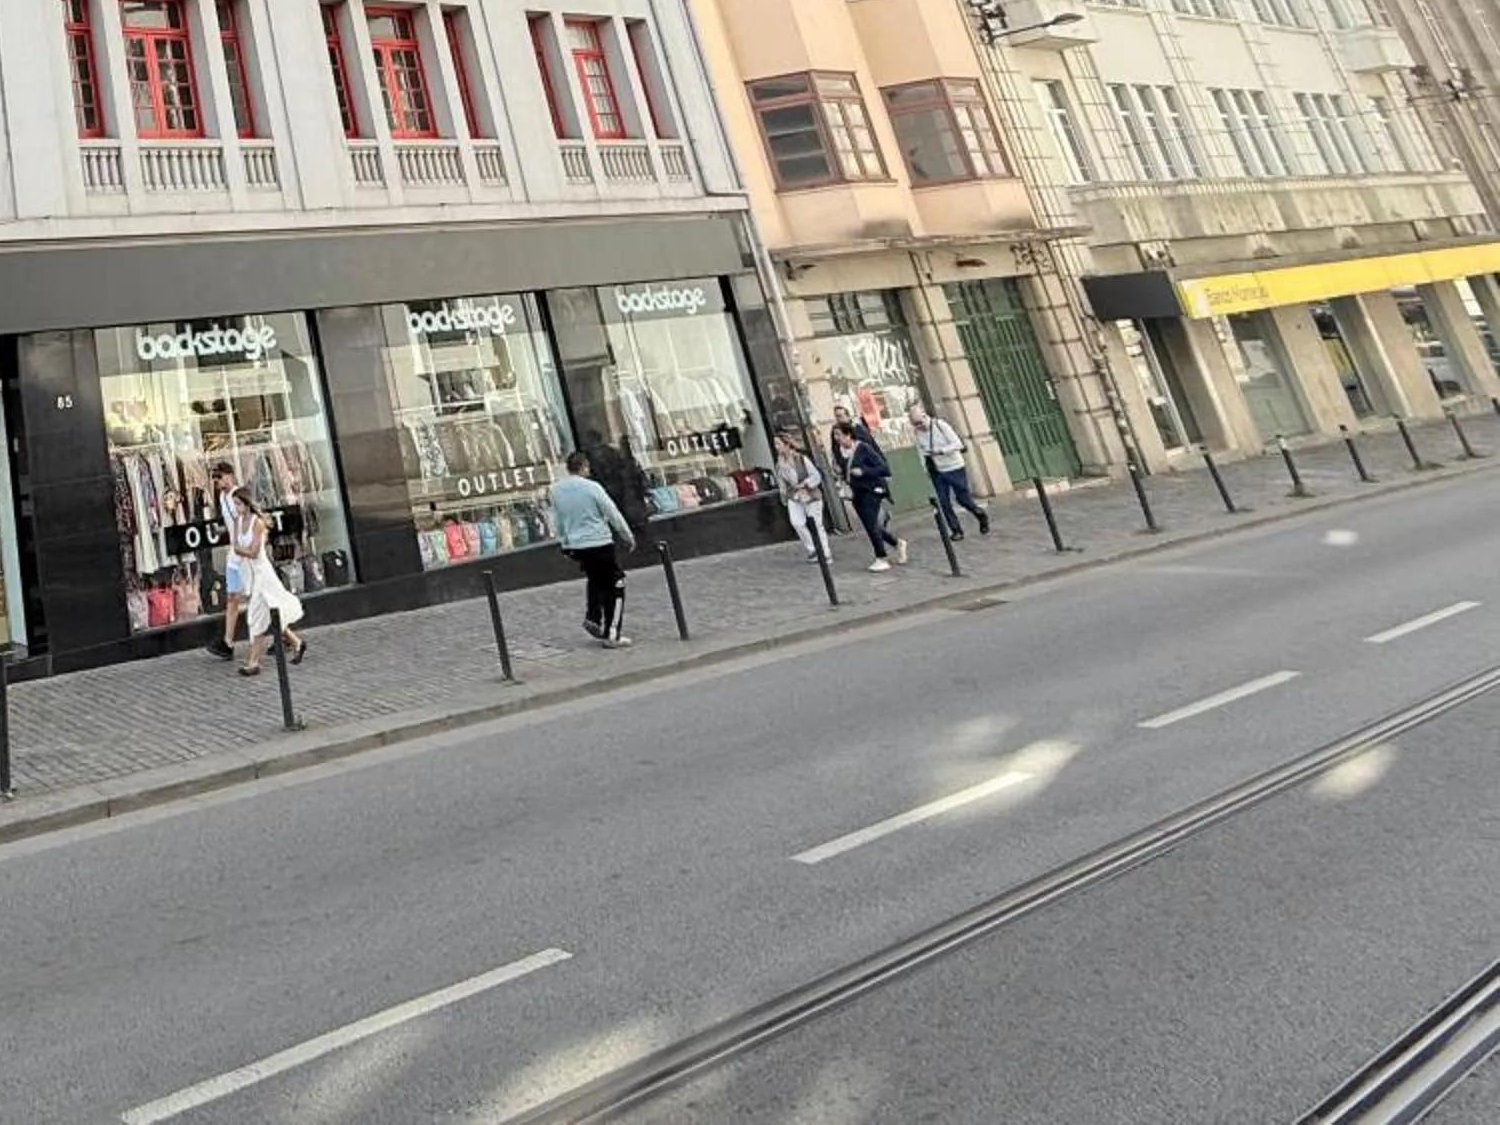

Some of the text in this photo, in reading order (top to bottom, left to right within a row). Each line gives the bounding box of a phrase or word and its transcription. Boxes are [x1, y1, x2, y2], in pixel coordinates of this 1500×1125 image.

[615, 284, 706, 314] backstage
[136, 323, 277, 360] backstage
[667, 431, 729, 456] OUTLET
[458, 466, 535, 497] OUTLET
[185, 511, 284, 548] OUT
